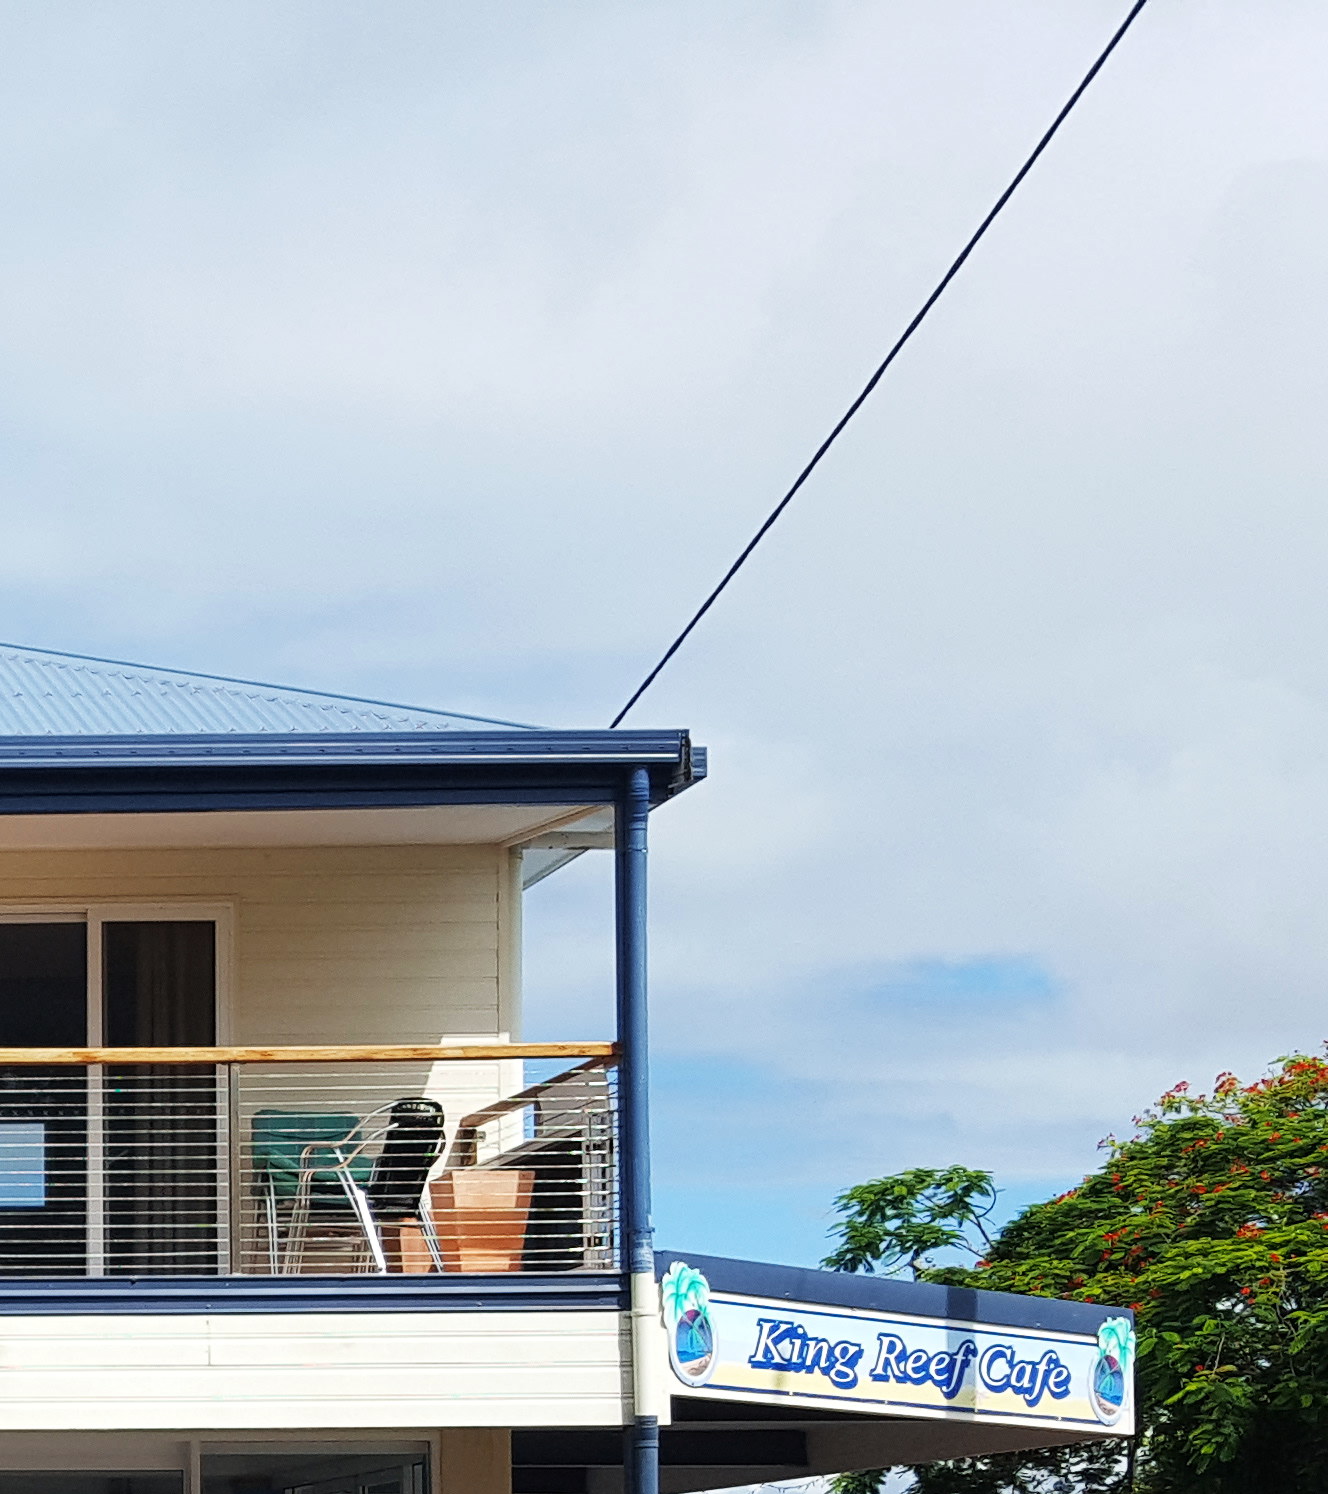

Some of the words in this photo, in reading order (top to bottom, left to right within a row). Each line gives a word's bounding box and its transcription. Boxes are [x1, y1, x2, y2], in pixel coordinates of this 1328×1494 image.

[749, 1318, 862, 1388] King
[870, 1333, 977, 1399] Reef
[979, 1344, 1072, 1407] Cafe
